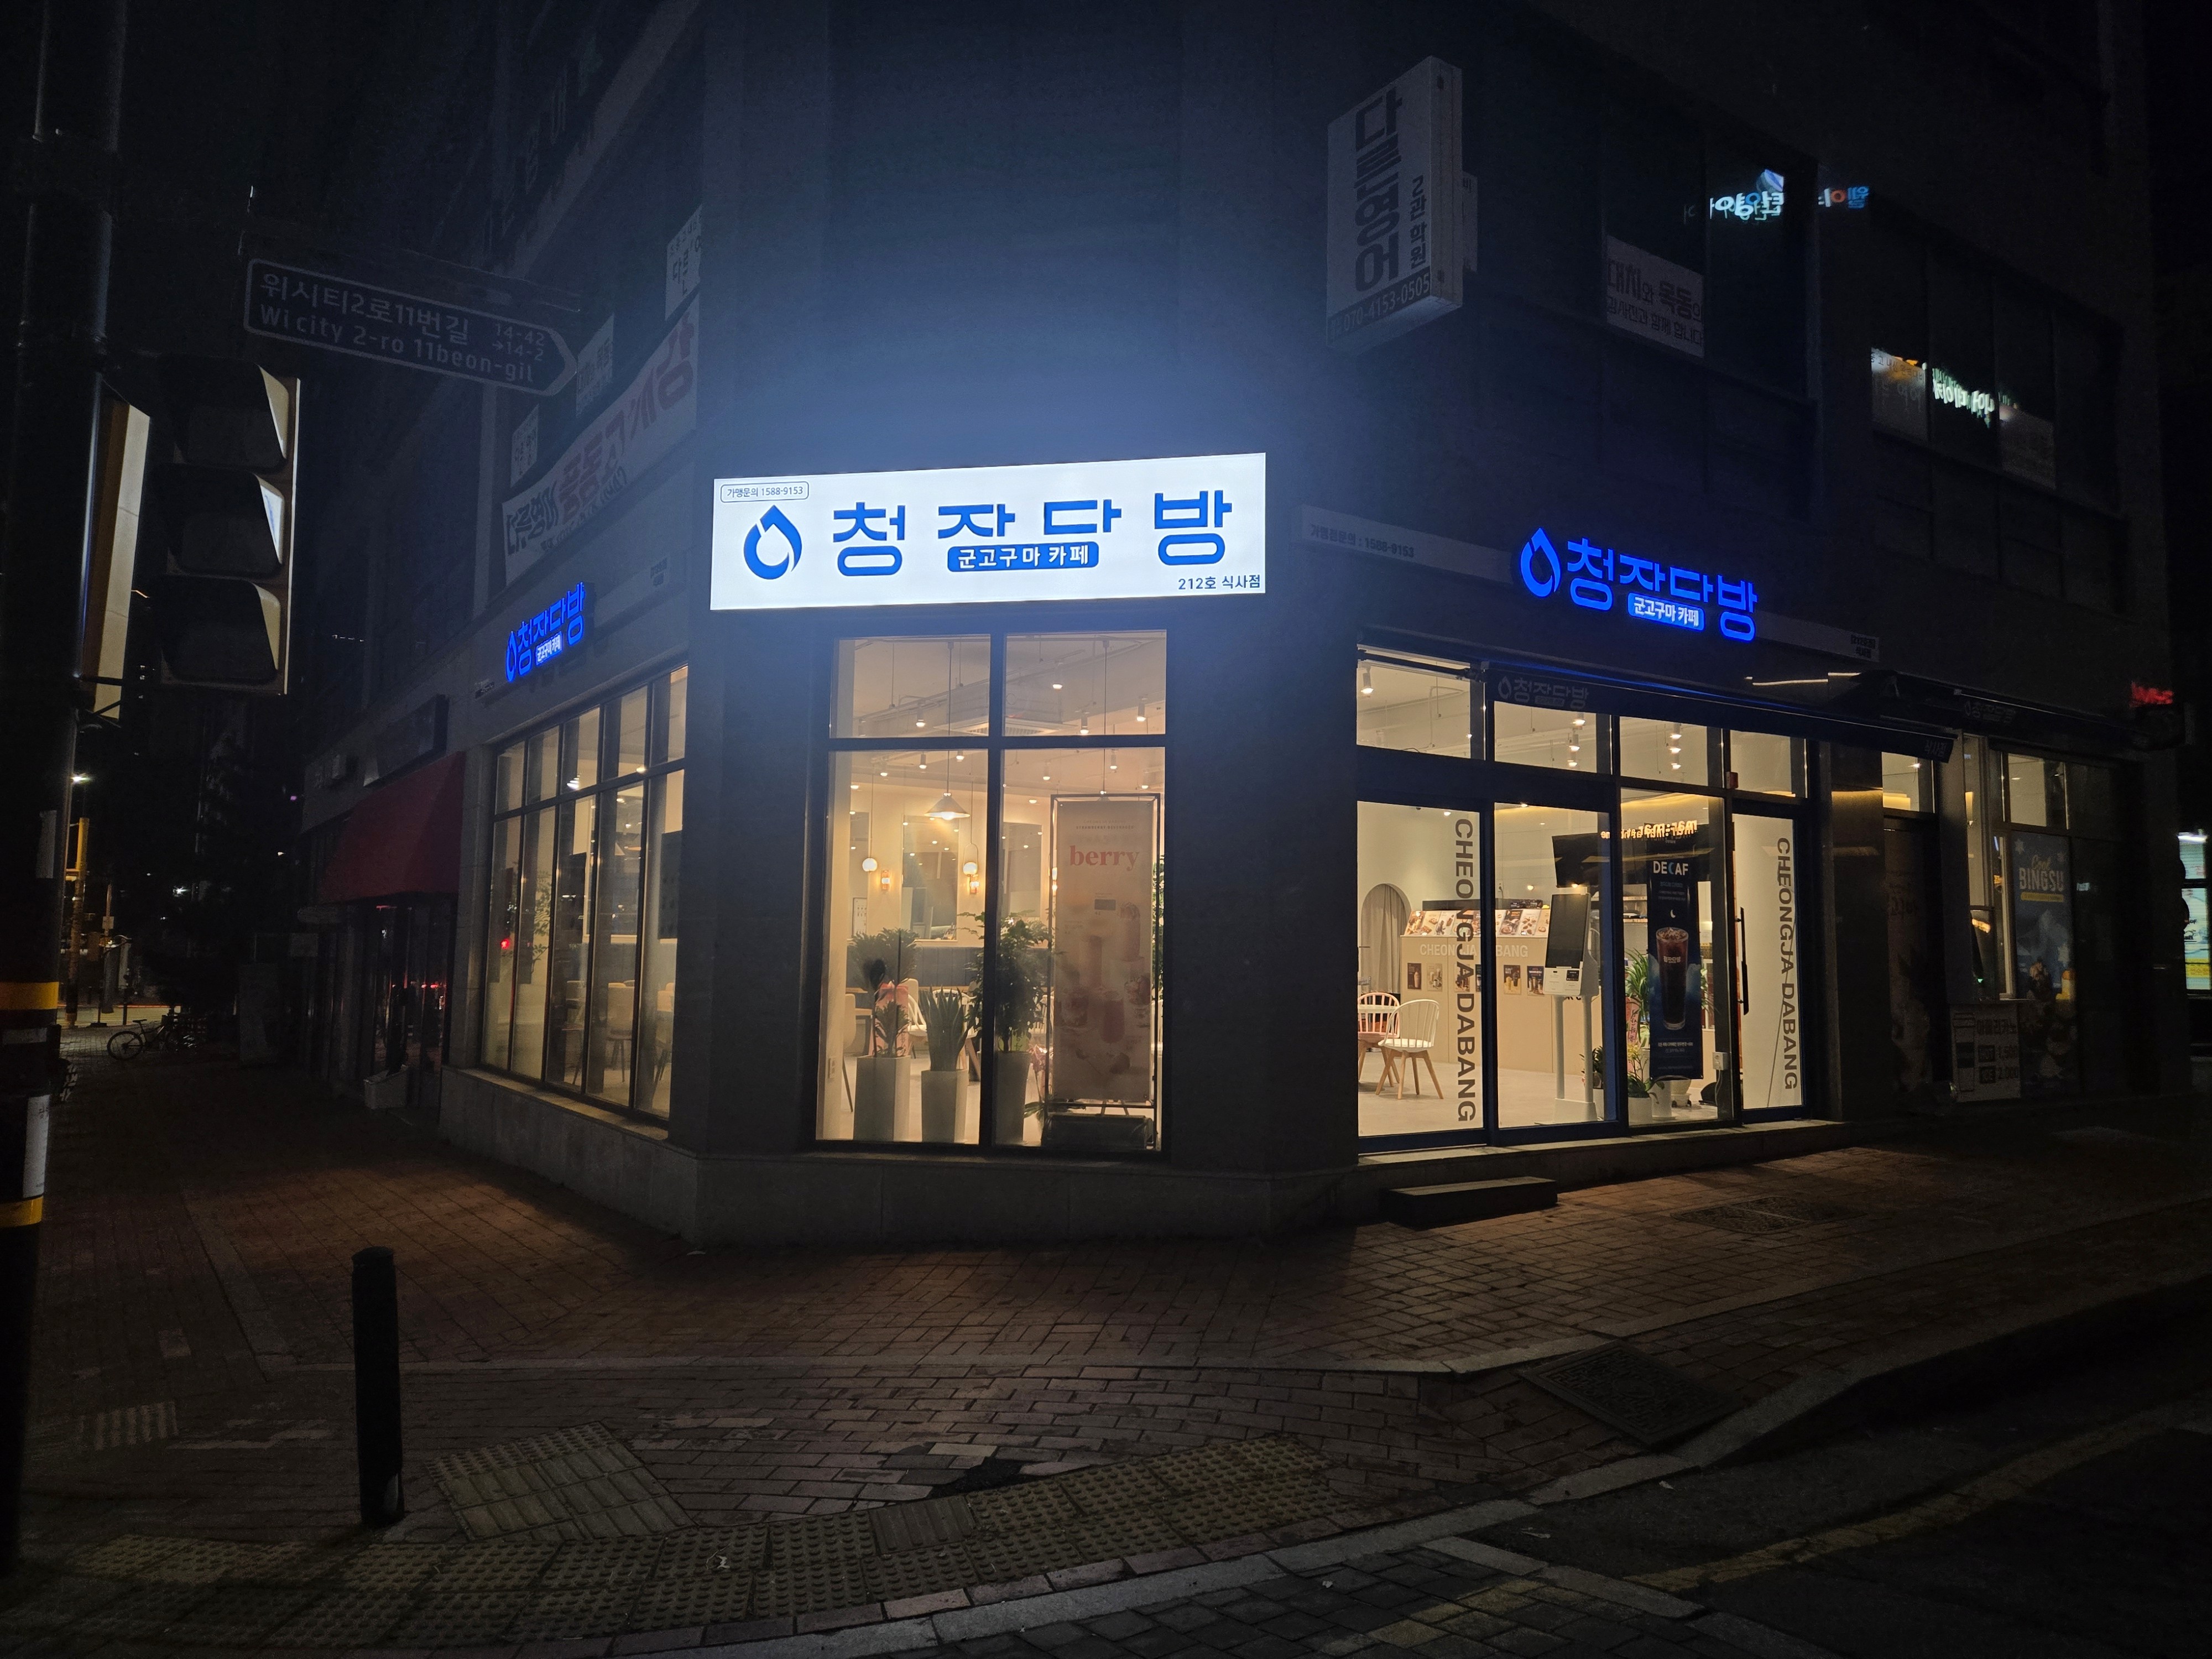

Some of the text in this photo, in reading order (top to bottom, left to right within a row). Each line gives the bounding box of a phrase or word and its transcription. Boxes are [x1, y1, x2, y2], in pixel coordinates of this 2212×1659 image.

[1354, 86, 1403, 292] 다른영어
[260, 273, 469, 346] 위시티2로11번길
[1608, 259, 1654, 305] 대치와
[353, 325, 404, 354] 2-ro
[414, 338, 534, 384] 11beon-gil
[727, 485, 804, 498] 가맹문의 1588-9153
[832, 490, 1232, 577] 청자다방
[958, 544, 1089, 570] 군고구마 카페
[1178, 574, 1261, 590] 212호 식사점
[1567, 537, 1758, 643] 청자다방
[518, 582, 585, 676] 청자다방
[1634, 596, 1700, 628] 군고구마 카페
[1070, 844, 1140, 872] berry
[2018, 867, 2064, 892] BINGSU
[1454, 818, 1476, 1123] CHEONGJA DABANG
[1776, 837, 1798, 1091] CHEONGJA DABANG
